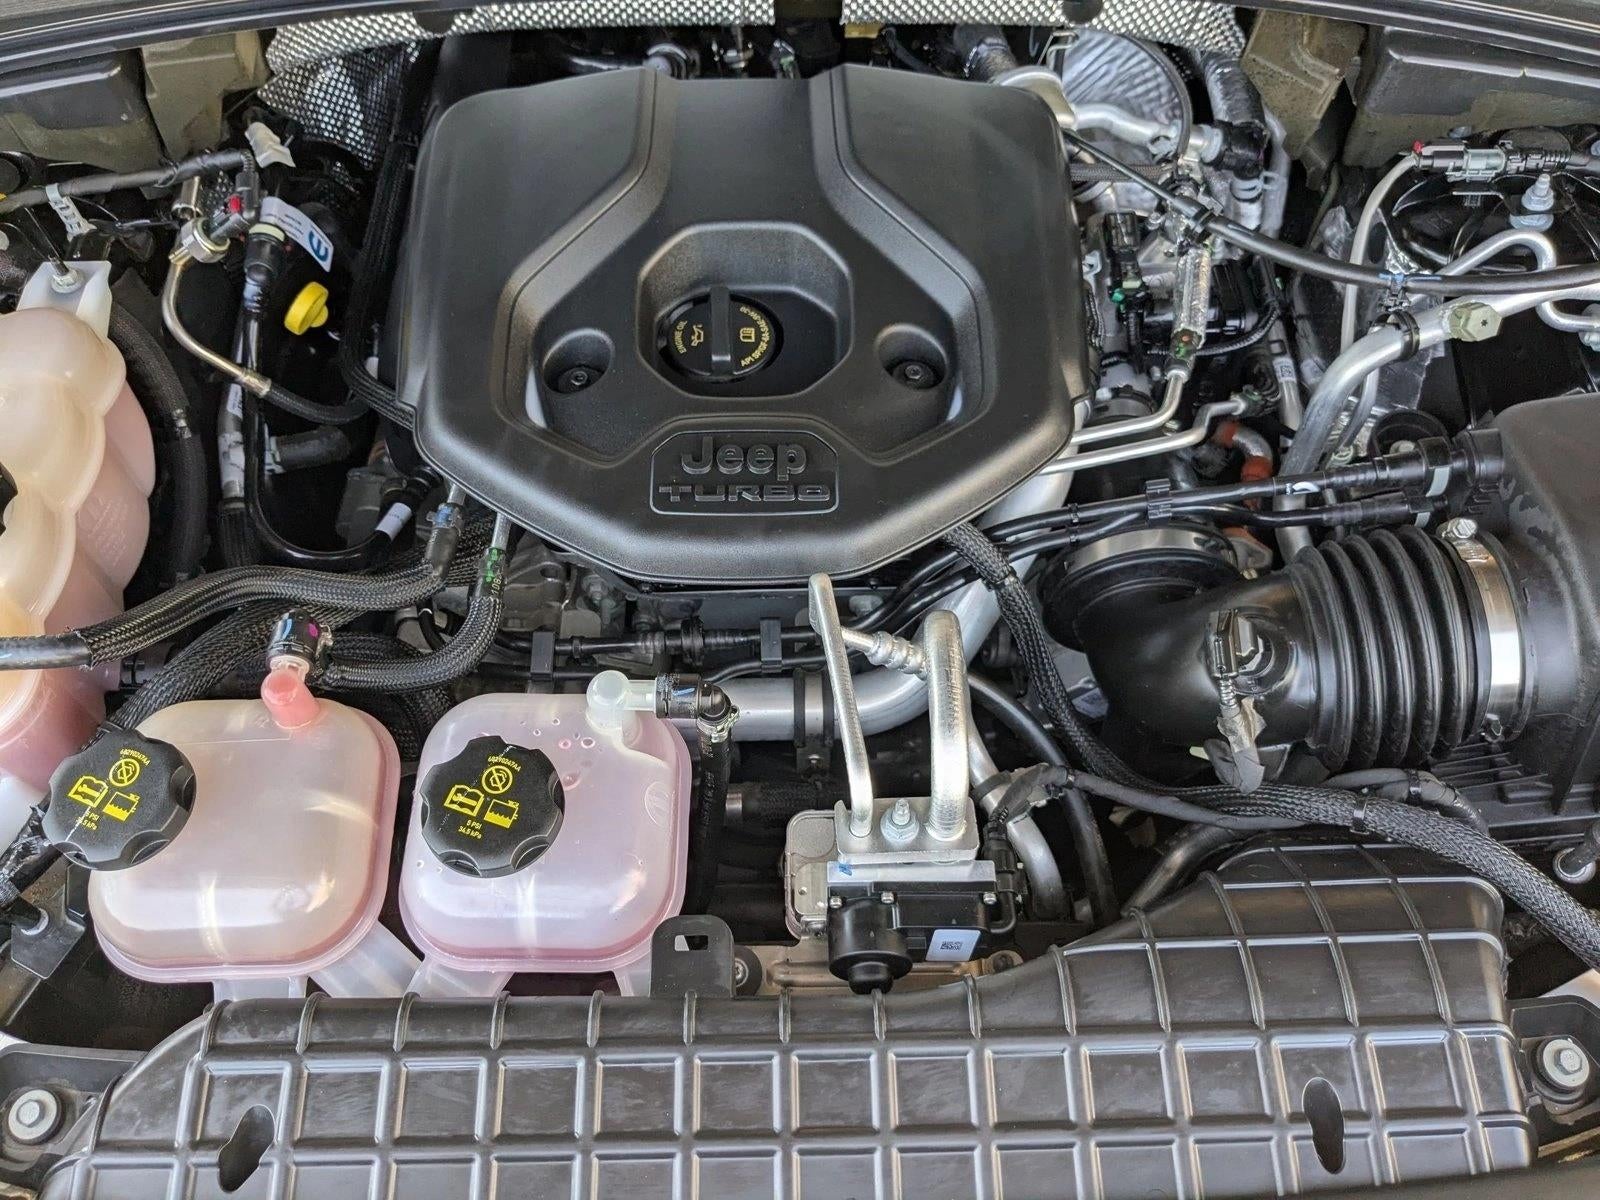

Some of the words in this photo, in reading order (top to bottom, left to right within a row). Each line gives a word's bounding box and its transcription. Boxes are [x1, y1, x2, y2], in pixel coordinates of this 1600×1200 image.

[676, 320, 688, 330] OIL
[675, 331, 687, 354] ENGINE
[740, 356, 755, 367] API
[681, 436, 807, 481] Jeep
[658, 484, 831, 502] TURBO
[471, 821, 482, 830] PSI
